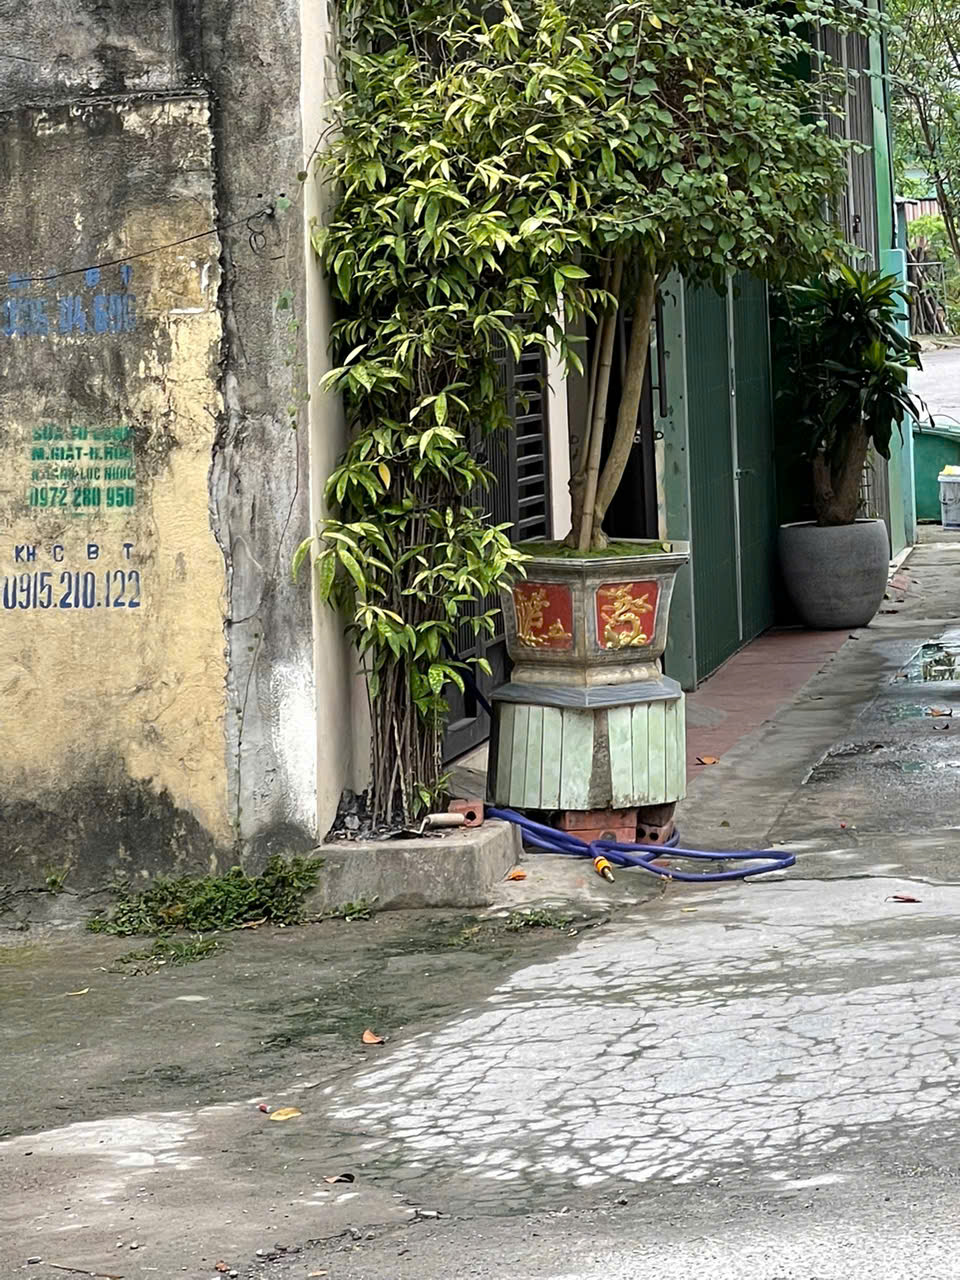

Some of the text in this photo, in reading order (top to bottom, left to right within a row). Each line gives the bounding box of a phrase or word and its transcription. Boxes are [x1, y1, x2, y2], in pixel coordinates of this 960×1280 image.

[29, 486, 135, 508] 0972 280 950
[87, 544, 99, 559] B
[123, 543, 133, 559] T
[3, 569, 140, 609] 0915.210.122
